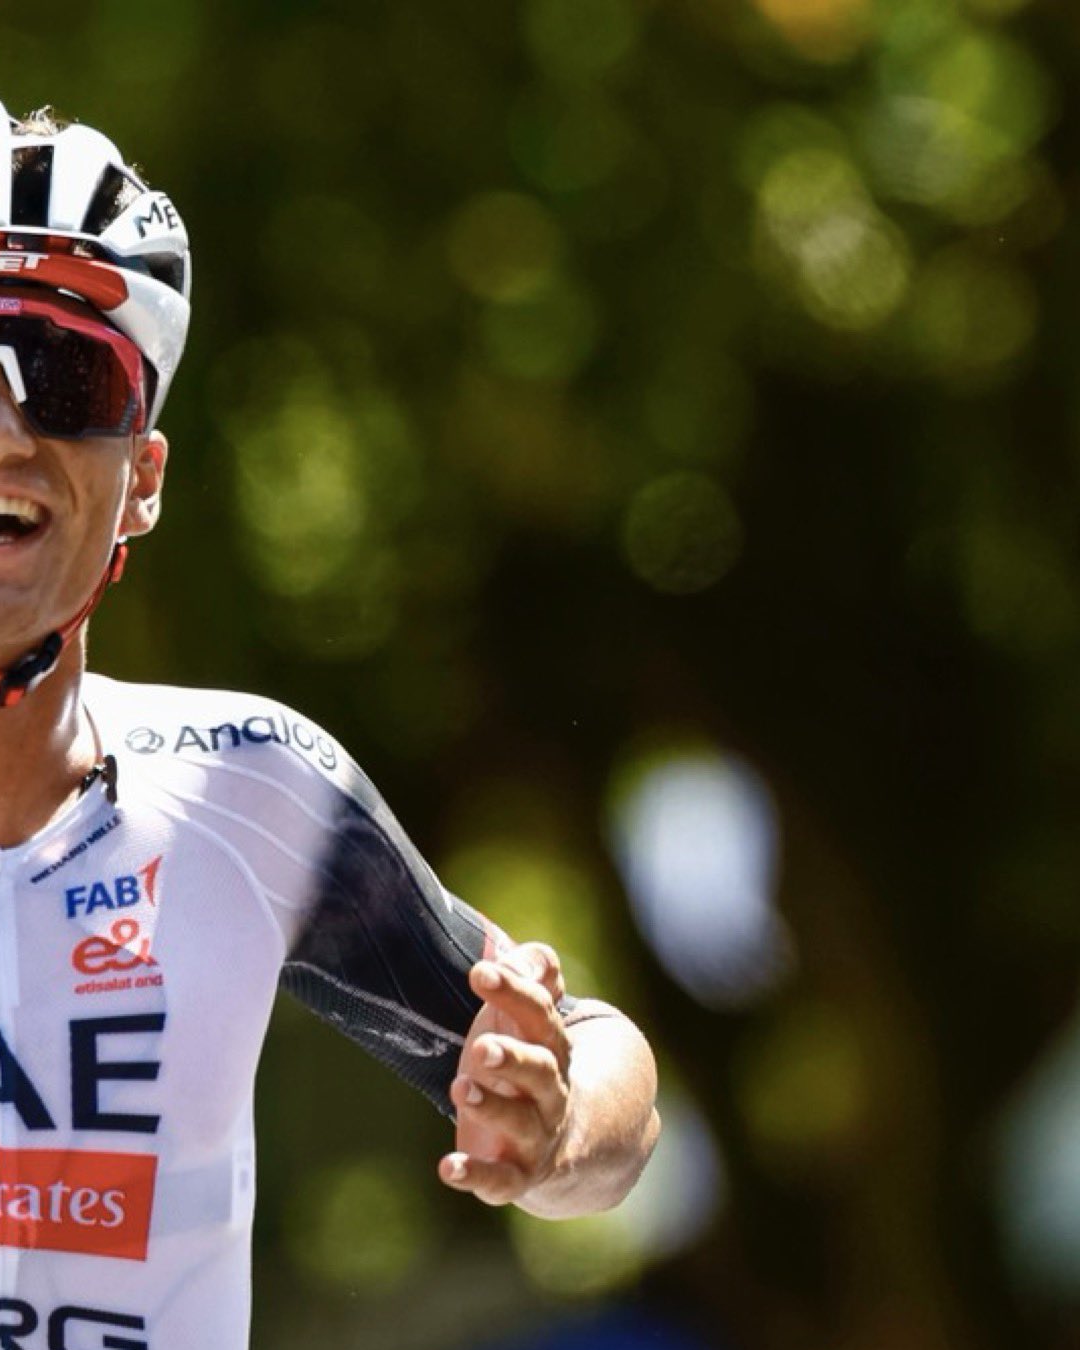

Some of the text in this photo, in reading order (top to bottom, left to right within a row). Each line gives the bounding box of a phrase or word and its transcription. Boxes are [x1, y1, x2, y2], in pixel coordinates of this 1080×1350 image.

[133, 196, 178, 238] ME
[173, 711, 337, 770] Analog
[64, 875, 141, 919] FAB
